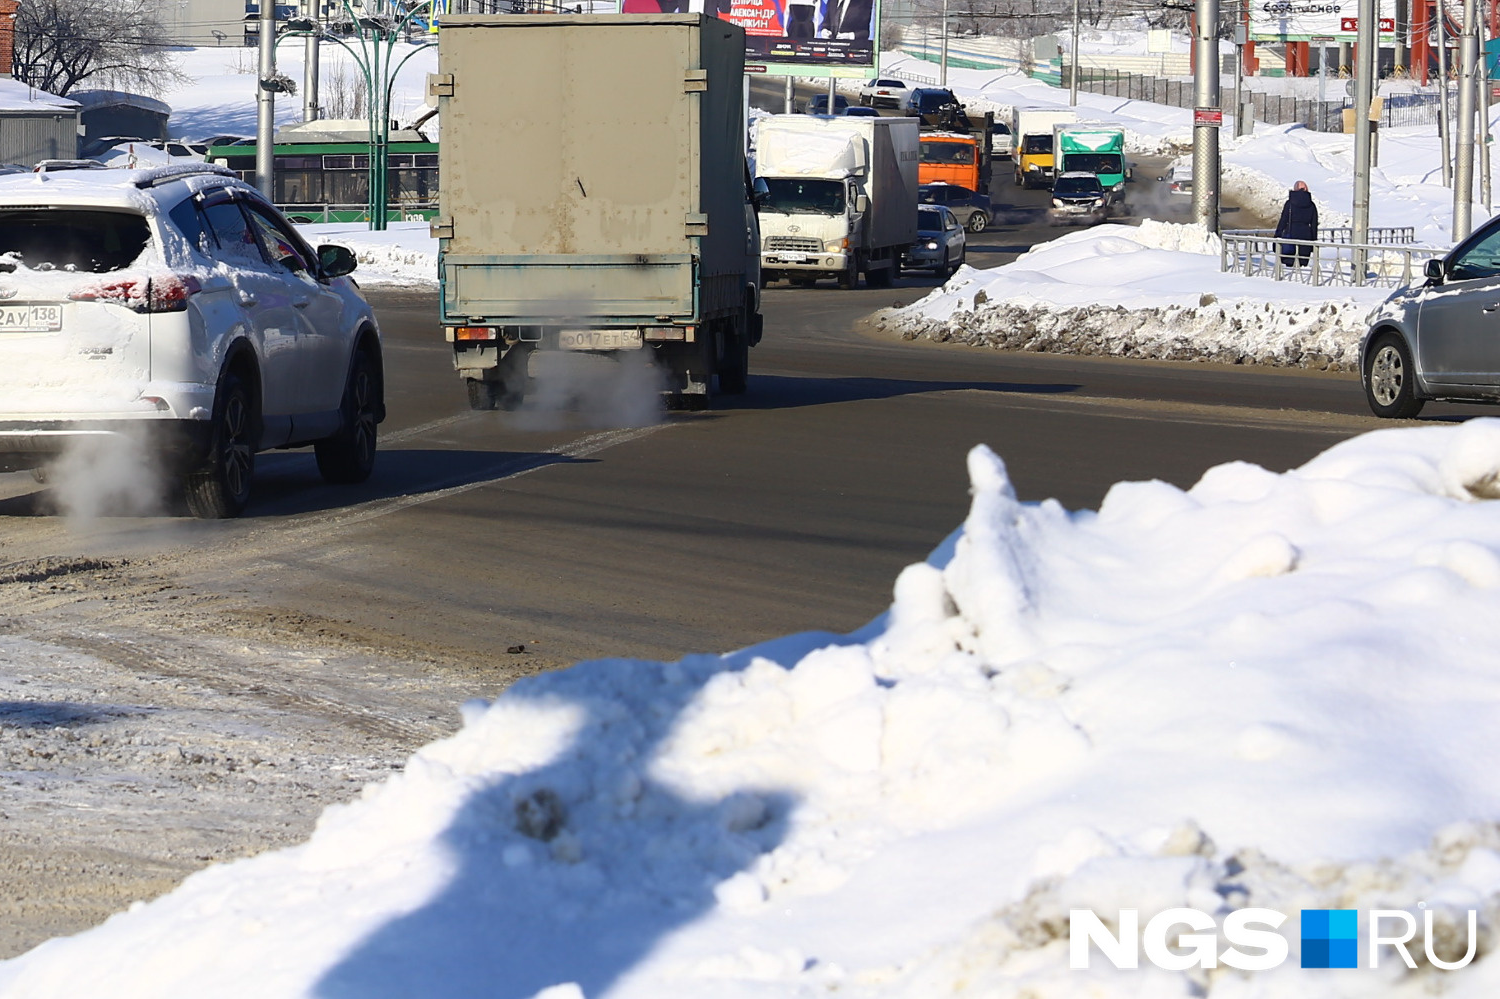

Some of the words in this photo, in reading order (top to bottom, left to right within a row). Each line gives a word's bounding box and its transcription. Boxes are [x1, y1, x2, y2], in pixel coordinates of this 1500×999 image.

[729, 8, 776, 20] АЛЕКСАНДР
[31, 307, 56, 321] 138
[566, 332, 620, 346] О017ЕТ
